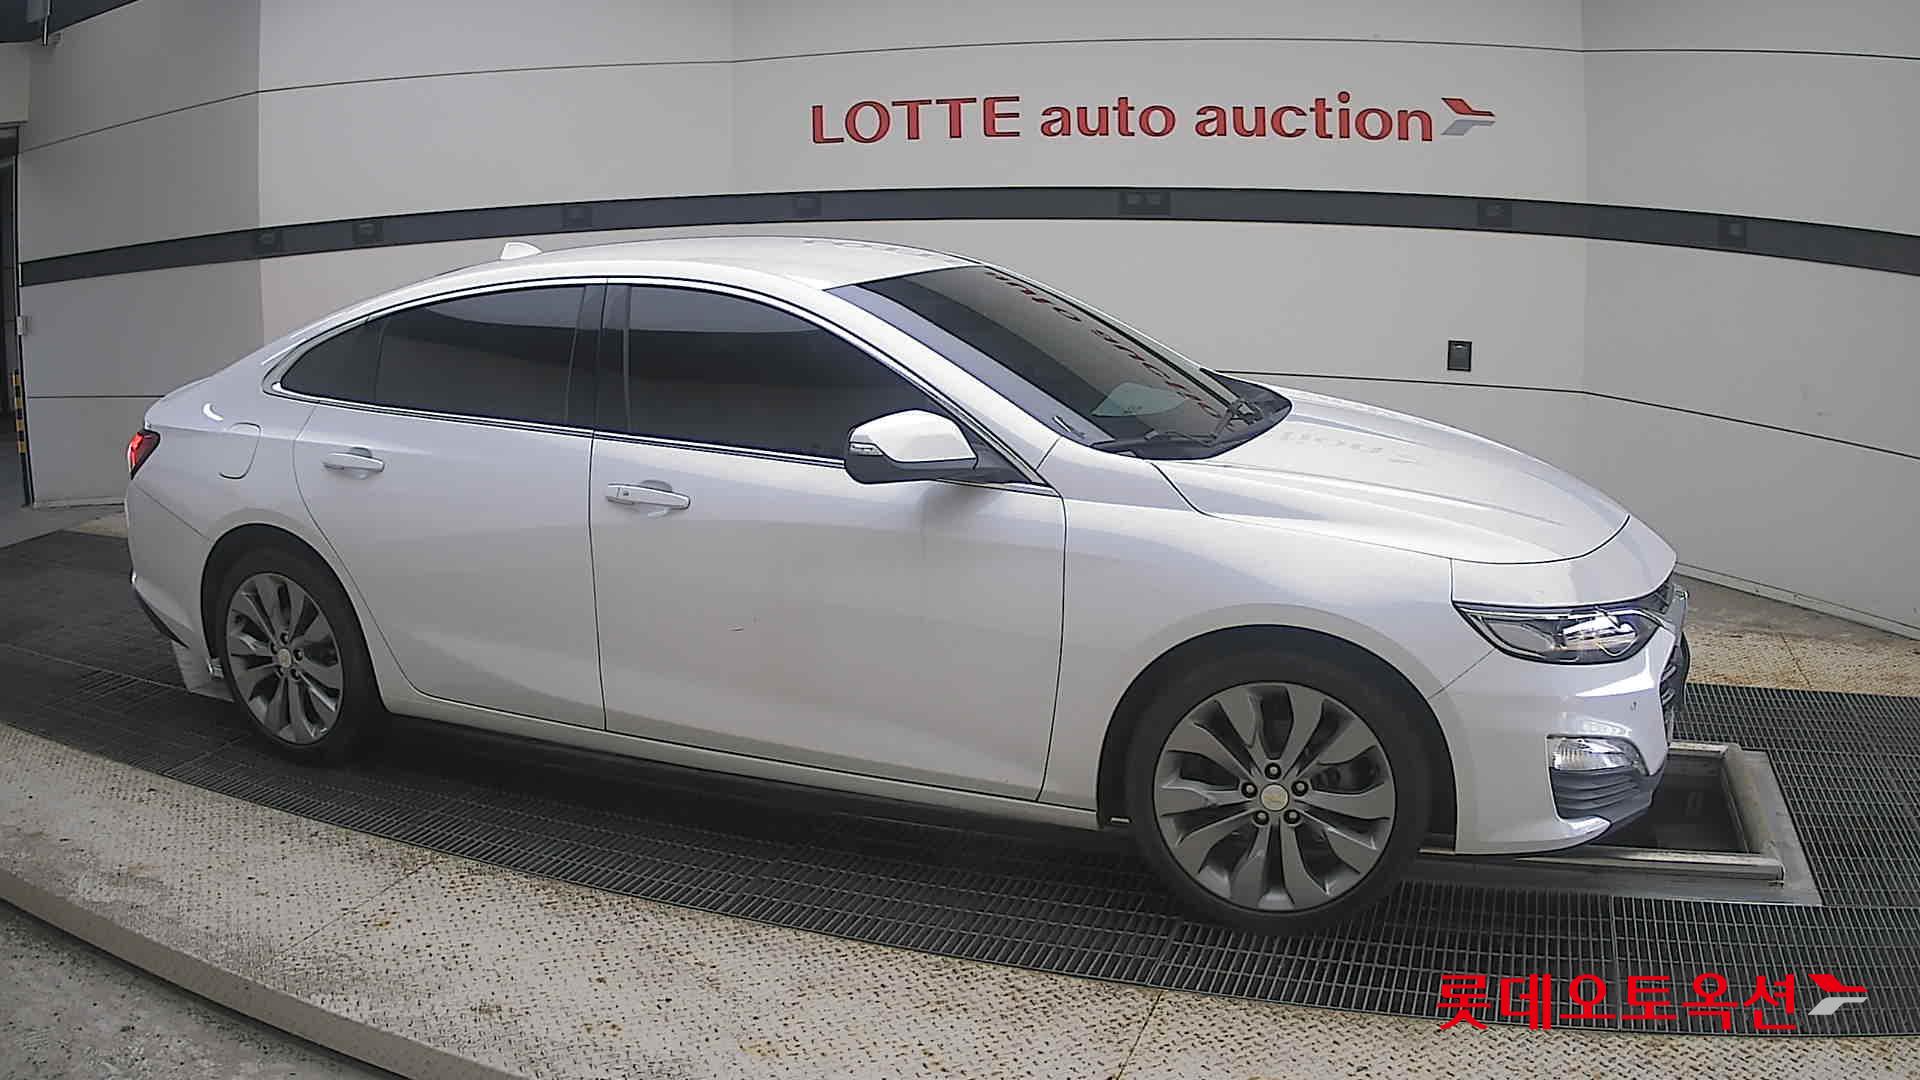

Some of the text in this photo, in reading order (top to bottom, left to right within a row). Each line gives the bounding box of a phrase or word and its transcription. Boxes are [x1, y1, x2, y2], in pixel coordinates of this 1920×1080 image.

[811, 91, 1433, 143] LOTTE auto auction
